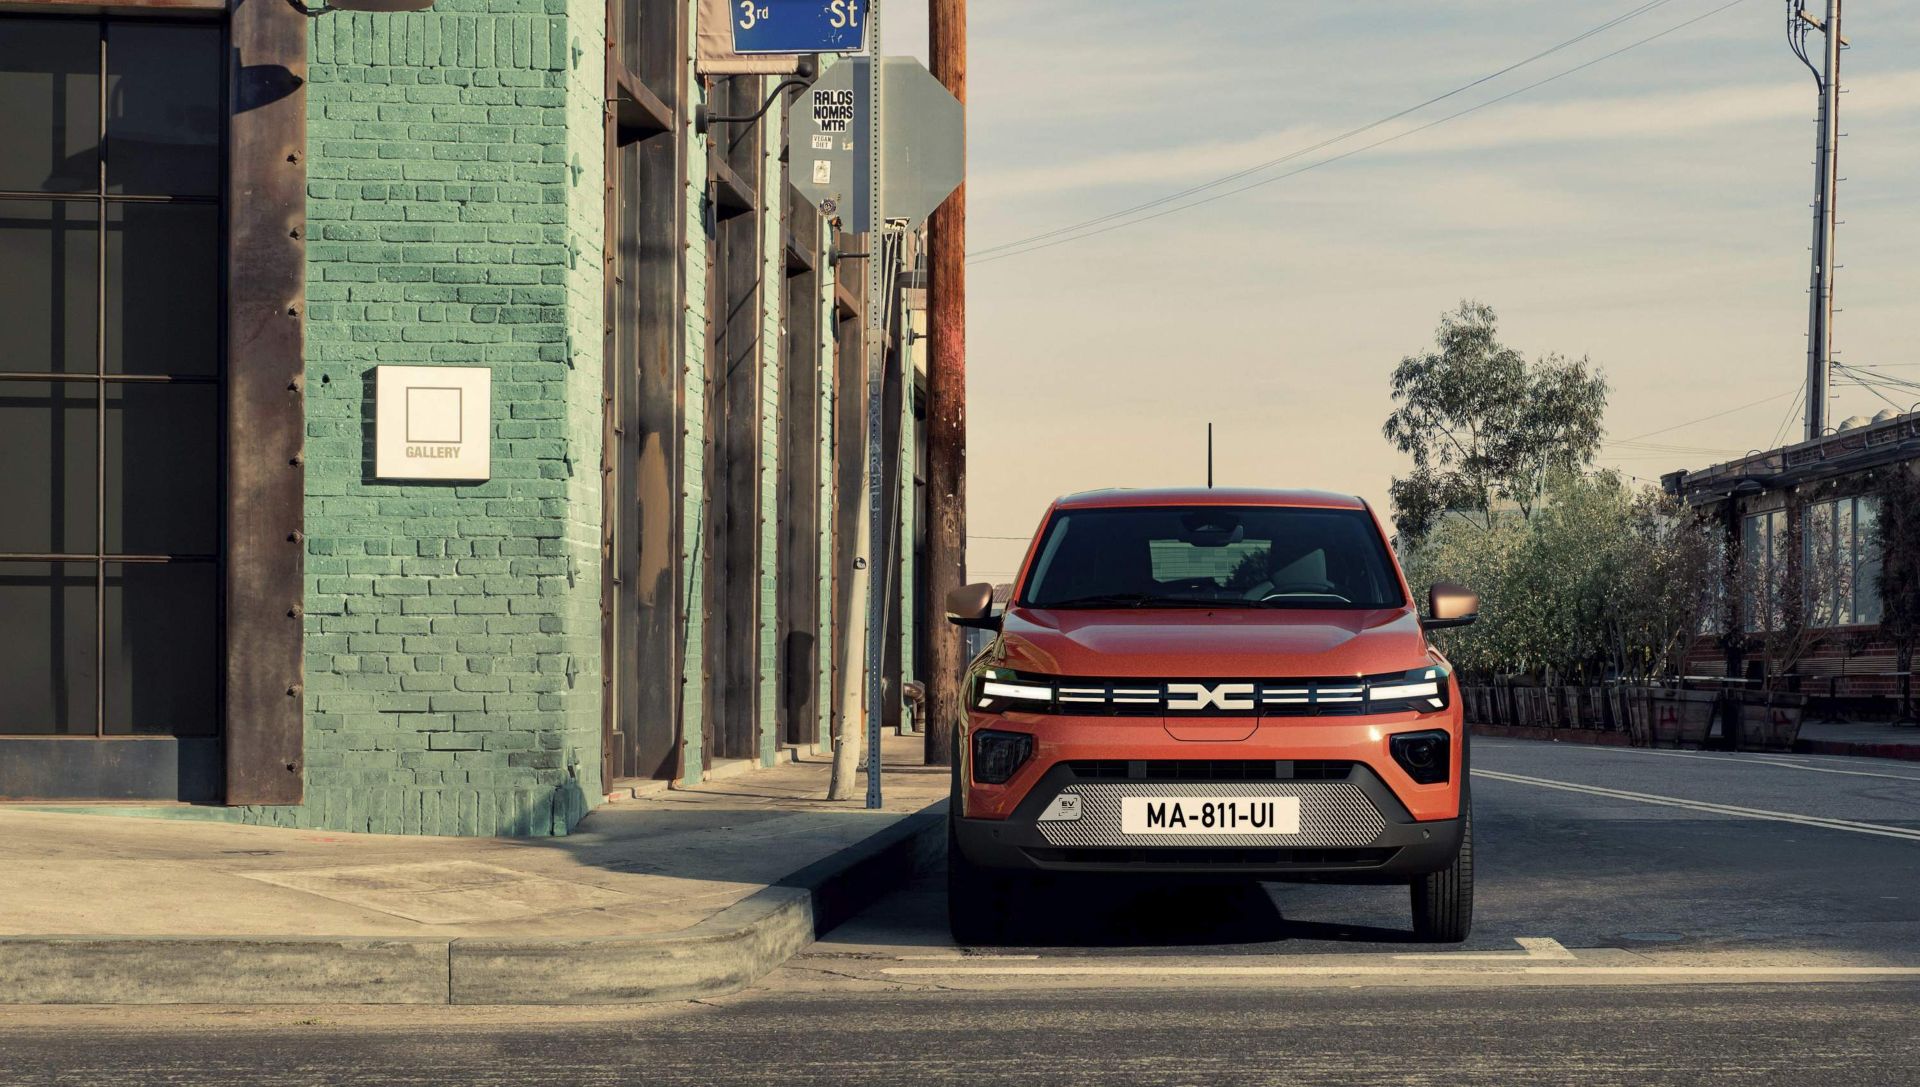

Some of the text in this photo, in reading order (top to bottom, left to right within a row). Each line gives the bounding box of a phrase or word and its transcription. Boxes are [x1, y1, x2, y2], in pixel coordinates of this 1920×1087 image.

[739, 0, 858, 29] 3rd St
[814, 91, 853, 106] RALOS
[814, 106, 853, 120] NOMAS
[821, 120, 846, 131] MTA
[405, 446, 461, 459] GALLERY
[1147, 802, 1274, 828] MA-811-UI
